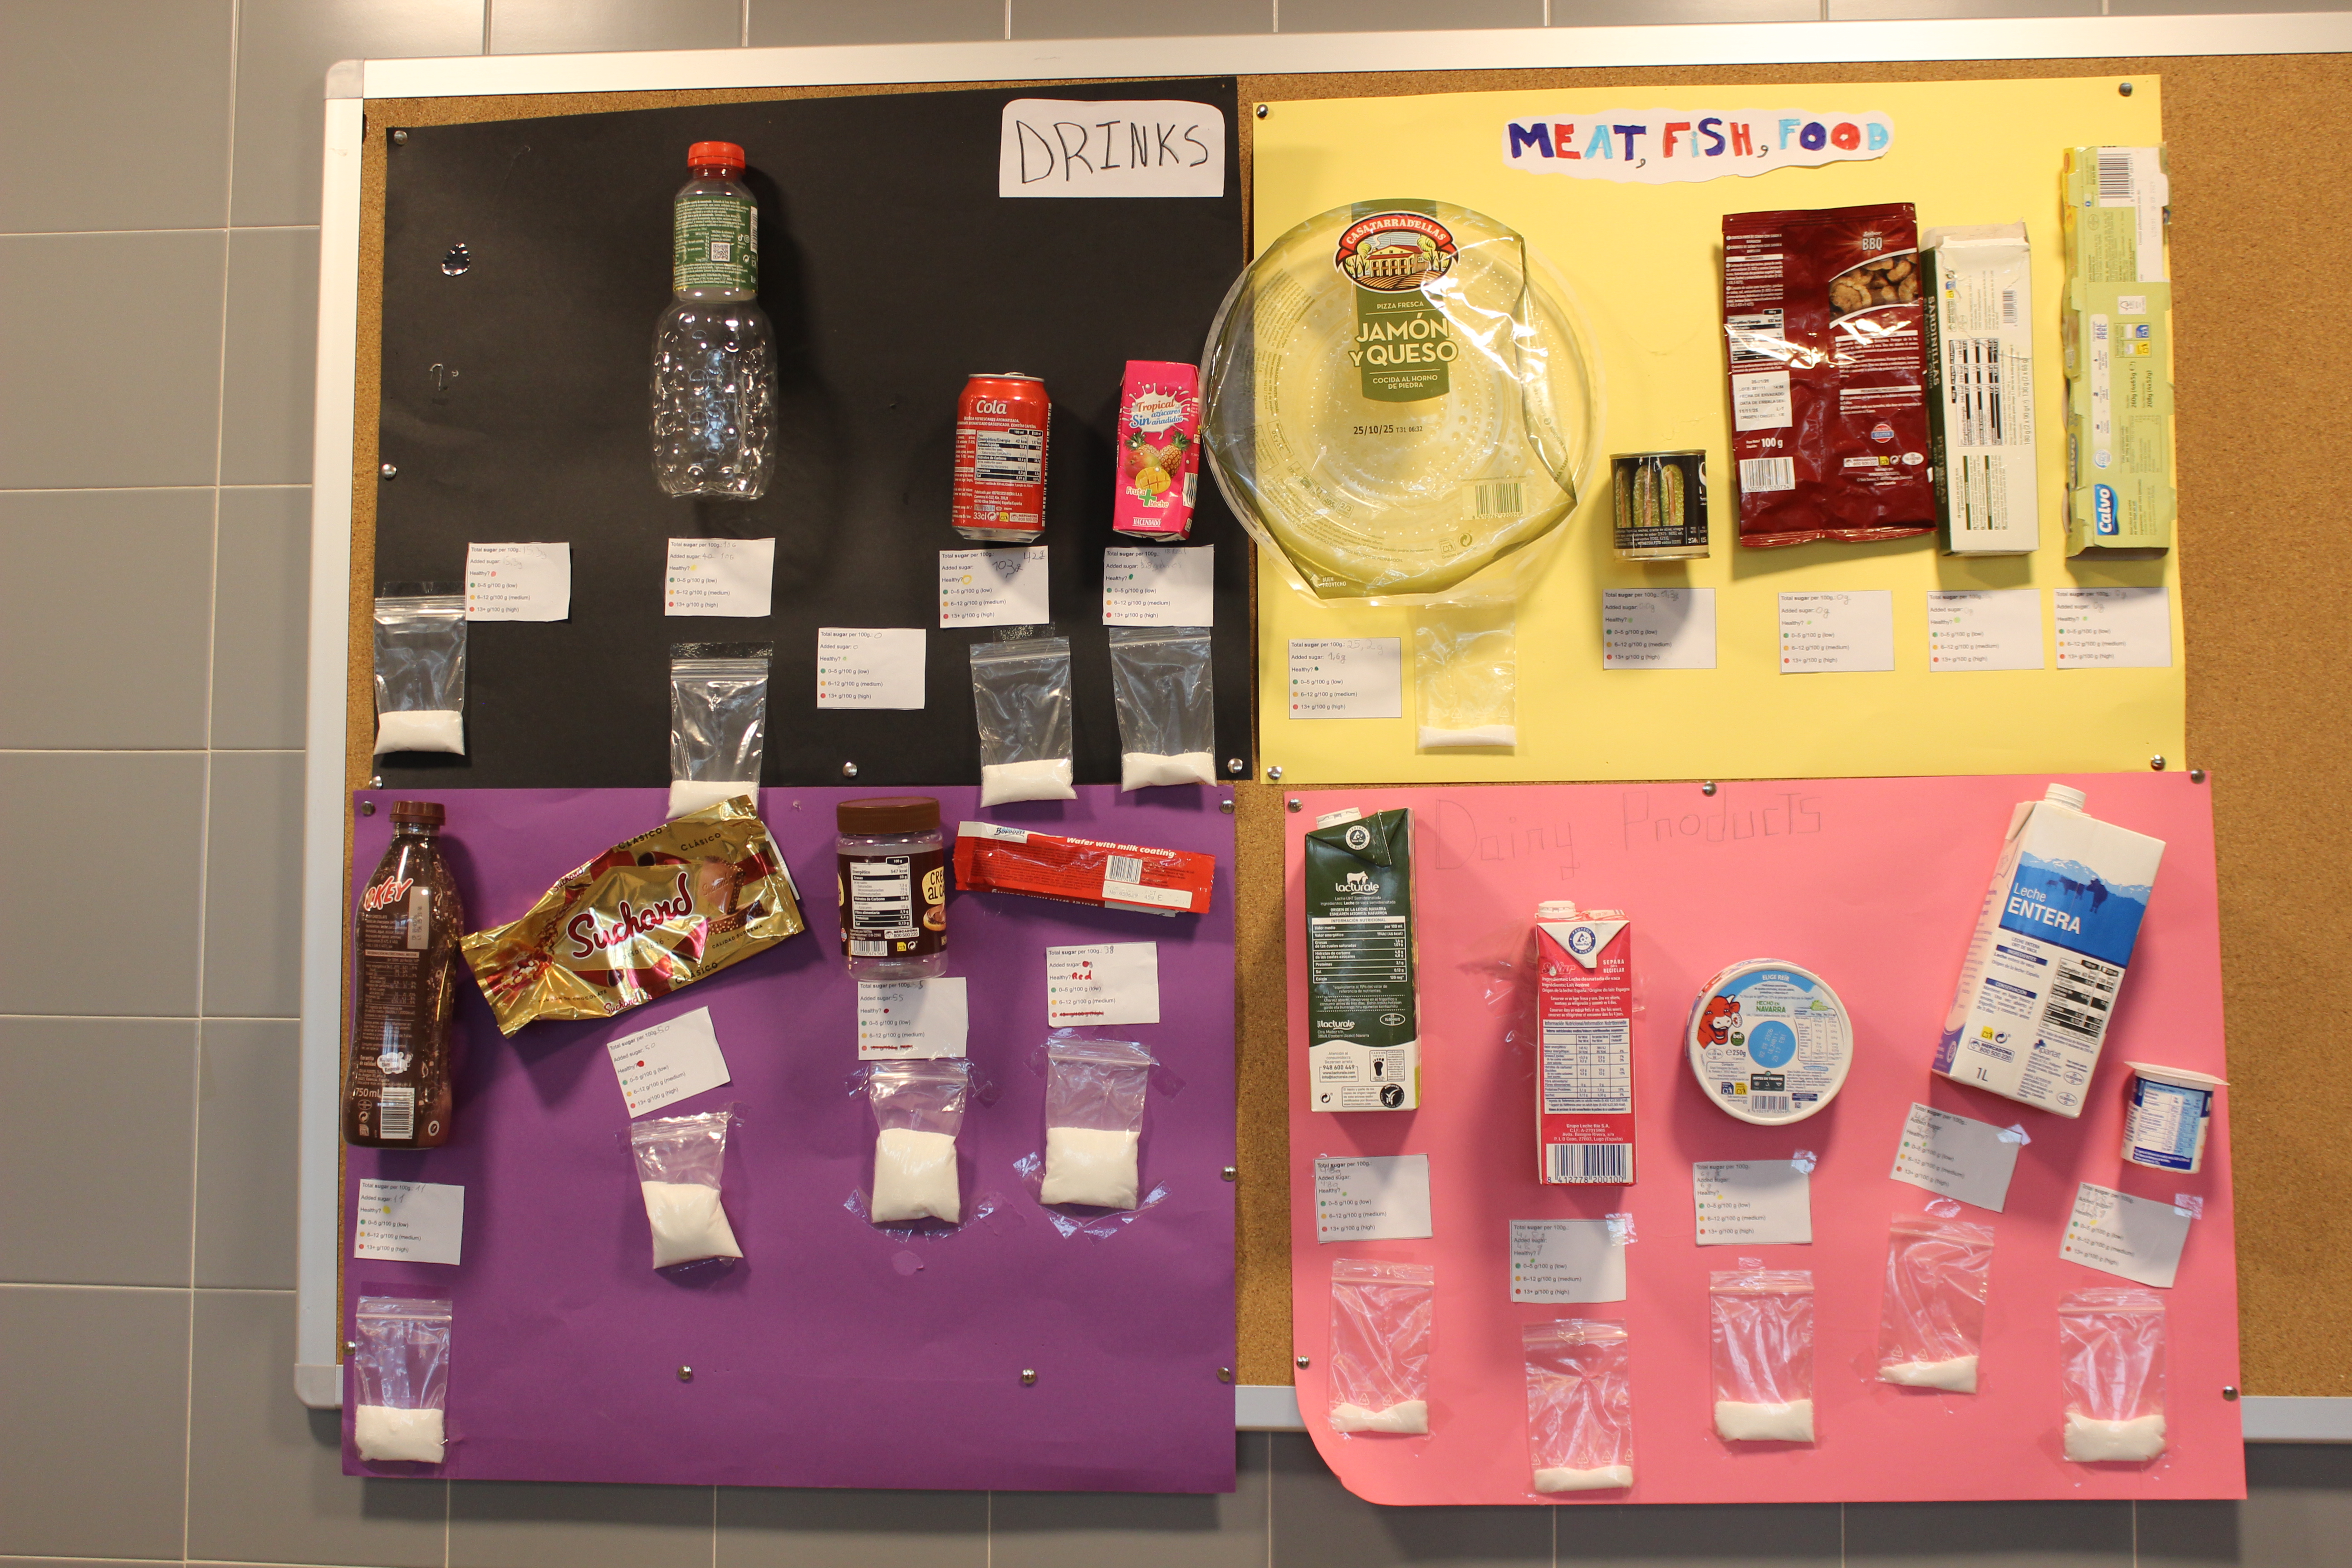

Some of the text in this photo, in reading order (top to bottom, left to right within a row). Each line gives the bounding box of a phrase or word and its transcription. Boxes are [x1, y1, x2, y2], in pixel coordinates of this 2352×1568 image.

[1016, 120, 1208, 184] DRINKS
[1508, 122, 1646, 168] MEAT,
[1779, 118, 1889, 151] FOOD
[1346, 218, 1447, 245] CASA TARRADELLAS
[1862, 238, 1882, 250] BBQ
[1356, 313, 1448, 342] JAMÓN
[1929, 296, 1940, 386] SARDINILLAS
[1349, 341, 1458, 366] Y QUESO
[976, 400, 1007, 415] Cola
[1137, 399, 1175, 412] Tropical
[1131, 409, 1182, 427] Sin azúcares añadidos
[1354, 425, 1394, 436] 25/10/25
[1761, 438, 1783, 448] 100 g
[1127, 487, 1146, 495] Fruta
[973, 512, 986, 520] 33cl
[1341, 504, 1351, 512] 2/3
[2099, 488, 2113, 534] Calvo
[1133, 518, 1161, 526] HACENDADO
[681, 832, 721, 851] CLÁSICO
[1067, 837, 1094, 846] Wafer
[1117, 844, 1137, 852] milk
[1139, 847, 1176, 859] coating
[1436, 799, 1580, 881] Dairy
[554, 867, 584, 892] Suchard
[1335, 882, 1379, 894] lacturale
[364, 876, 414, 911] OKEY
[2014, 882, 2047, 902] Leche
[567, 872, 694, 959] Suchard
[2008, 897, 2081, 935] ENTERA
[712, 924, 763, 949] CALIDAD SUPREMA
[623, 948, 643, 960] DESDE
[675, 962, 718, 985] CLÁSICO
[1072, 970, 1092, 980] Red
[573, 990, 607, 1000] CHOCOLATE
[603, 993, 639, 1014] Suchard
[1321, 1020, 1355, 1029] lacturale
[1981, 1043, 2012, 1056] MERCADONA
[1976, 1067, 1988, 1082] 1L
